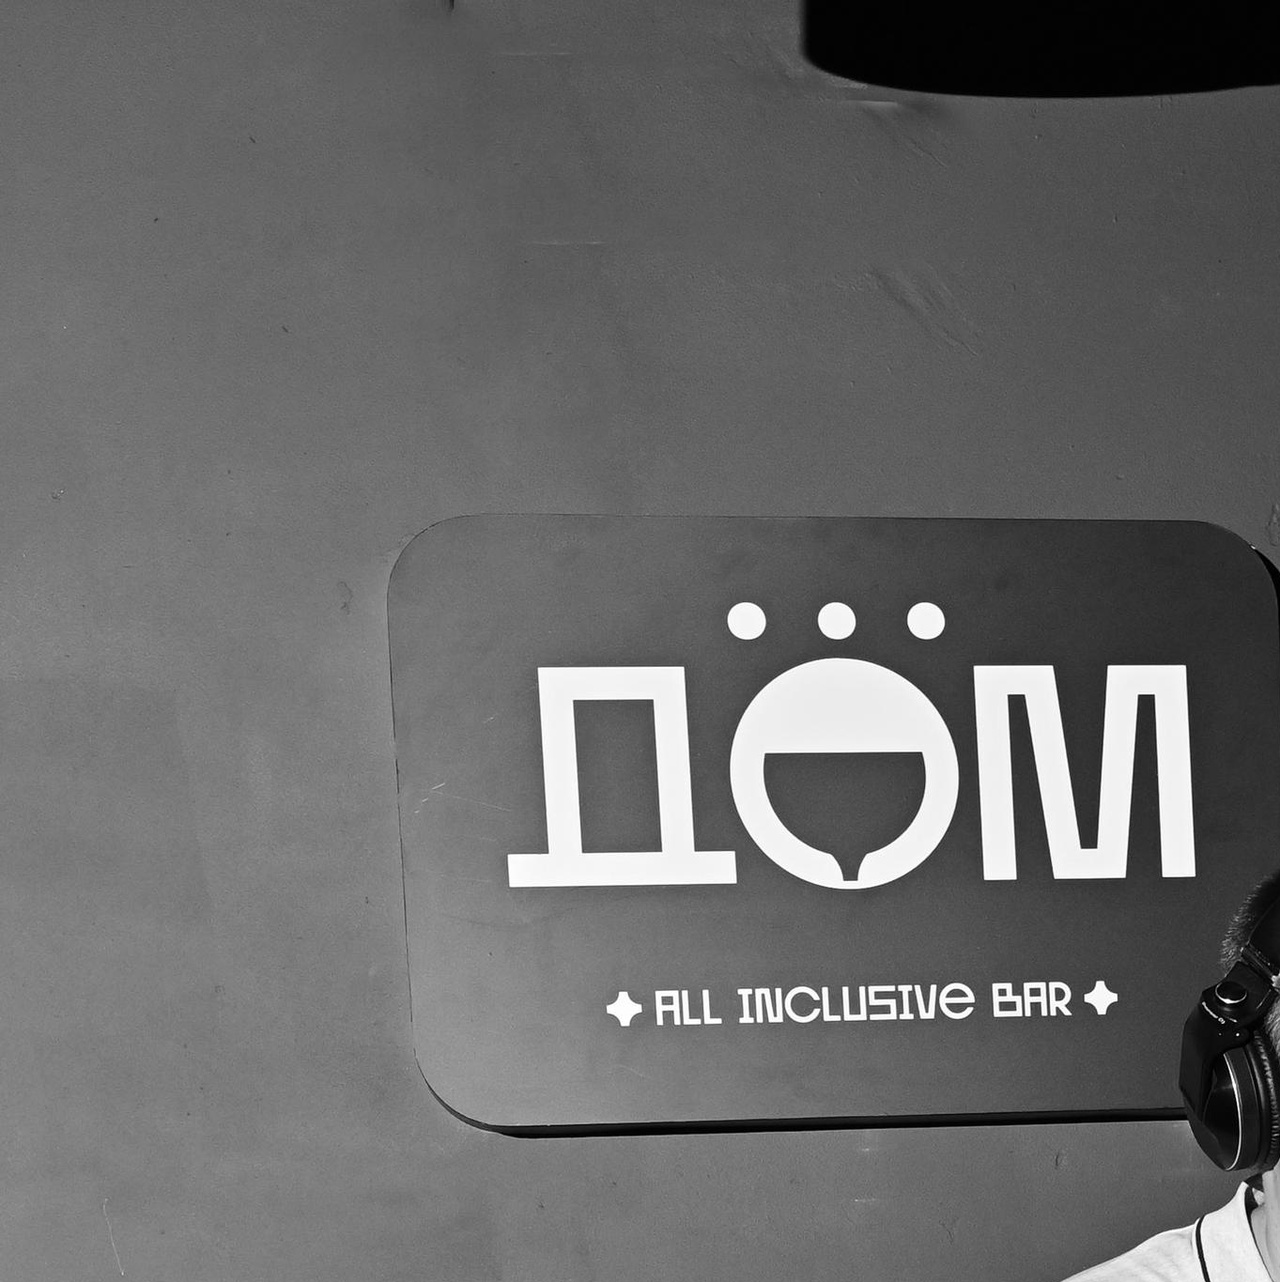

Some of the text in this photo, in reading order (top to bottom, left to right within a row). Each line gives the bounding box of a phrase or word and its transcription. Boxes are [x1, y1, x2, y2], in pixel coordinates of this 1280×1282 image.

[655, 982, 1072, 1025] ALL INCLUSIVE BAR
